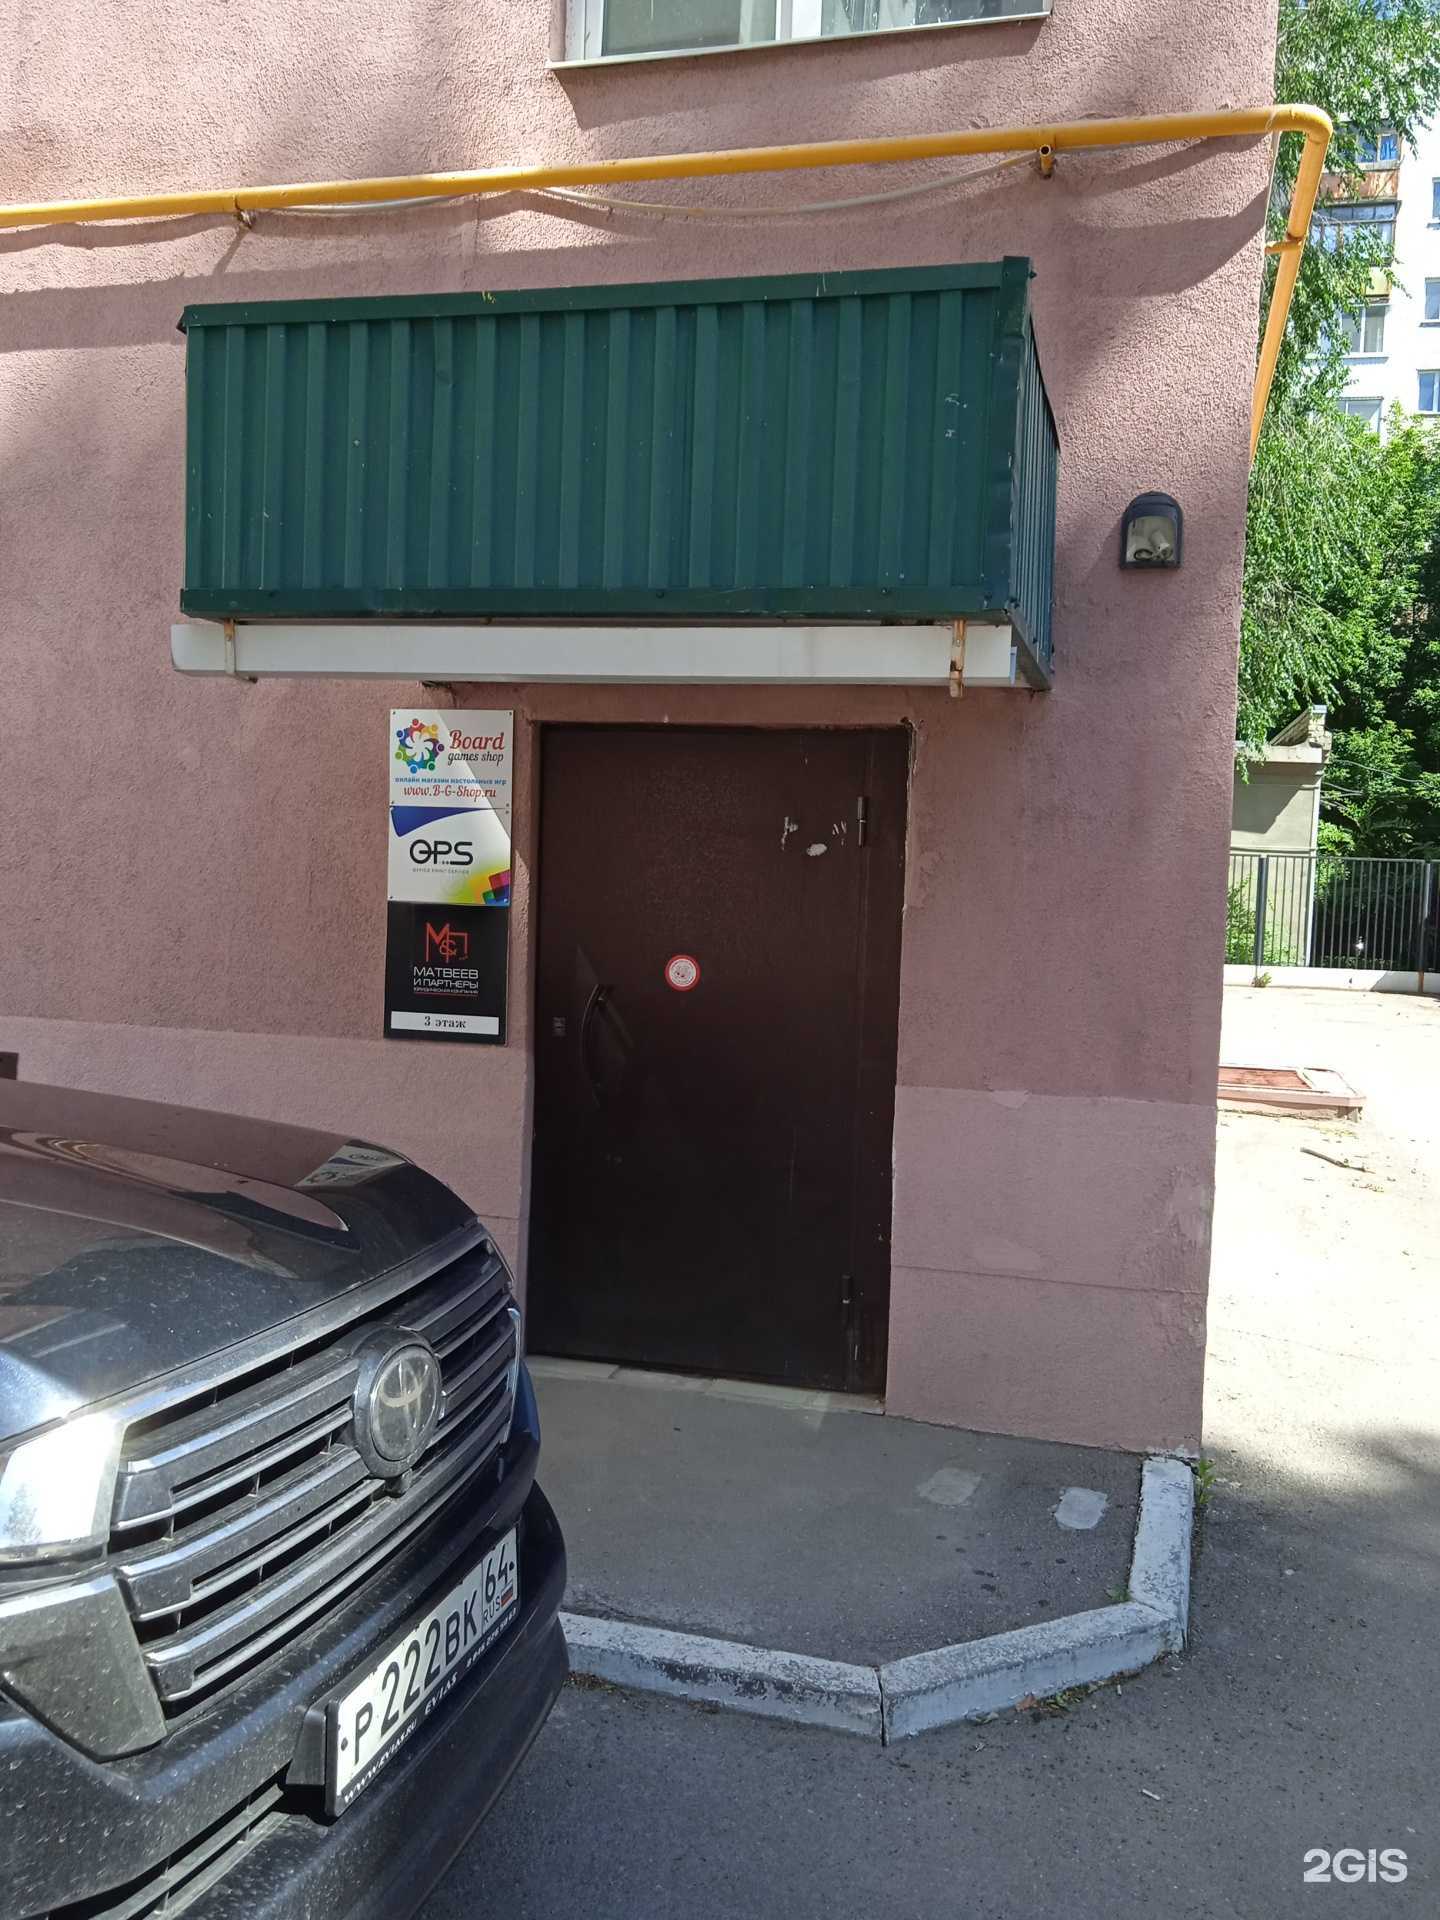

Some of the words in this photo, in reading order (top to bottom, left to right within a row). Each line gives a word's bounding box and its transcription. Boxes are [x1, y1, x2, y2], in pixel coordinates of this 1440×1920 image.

[449, 729, 505, 750] Board
[447, 751, 479, 766] games
[480, 752, 504, 767] shop
[494, 778, 507, 786] игр
[403, 784, 497, 802] www.B-G-Shop.ru
[413, 966, 479, 979] МАТВЕЕВ
[413, 978, 422, 986] И
[423, 978, 479, 989] ПАРТНЕРЫ
[424, 1015, 431, 1027] 3
[435, 1017, 467, 1029] этаж
[484, 1543, 510, 1605] 64
[483, 1594, 501, 1626] RUS
